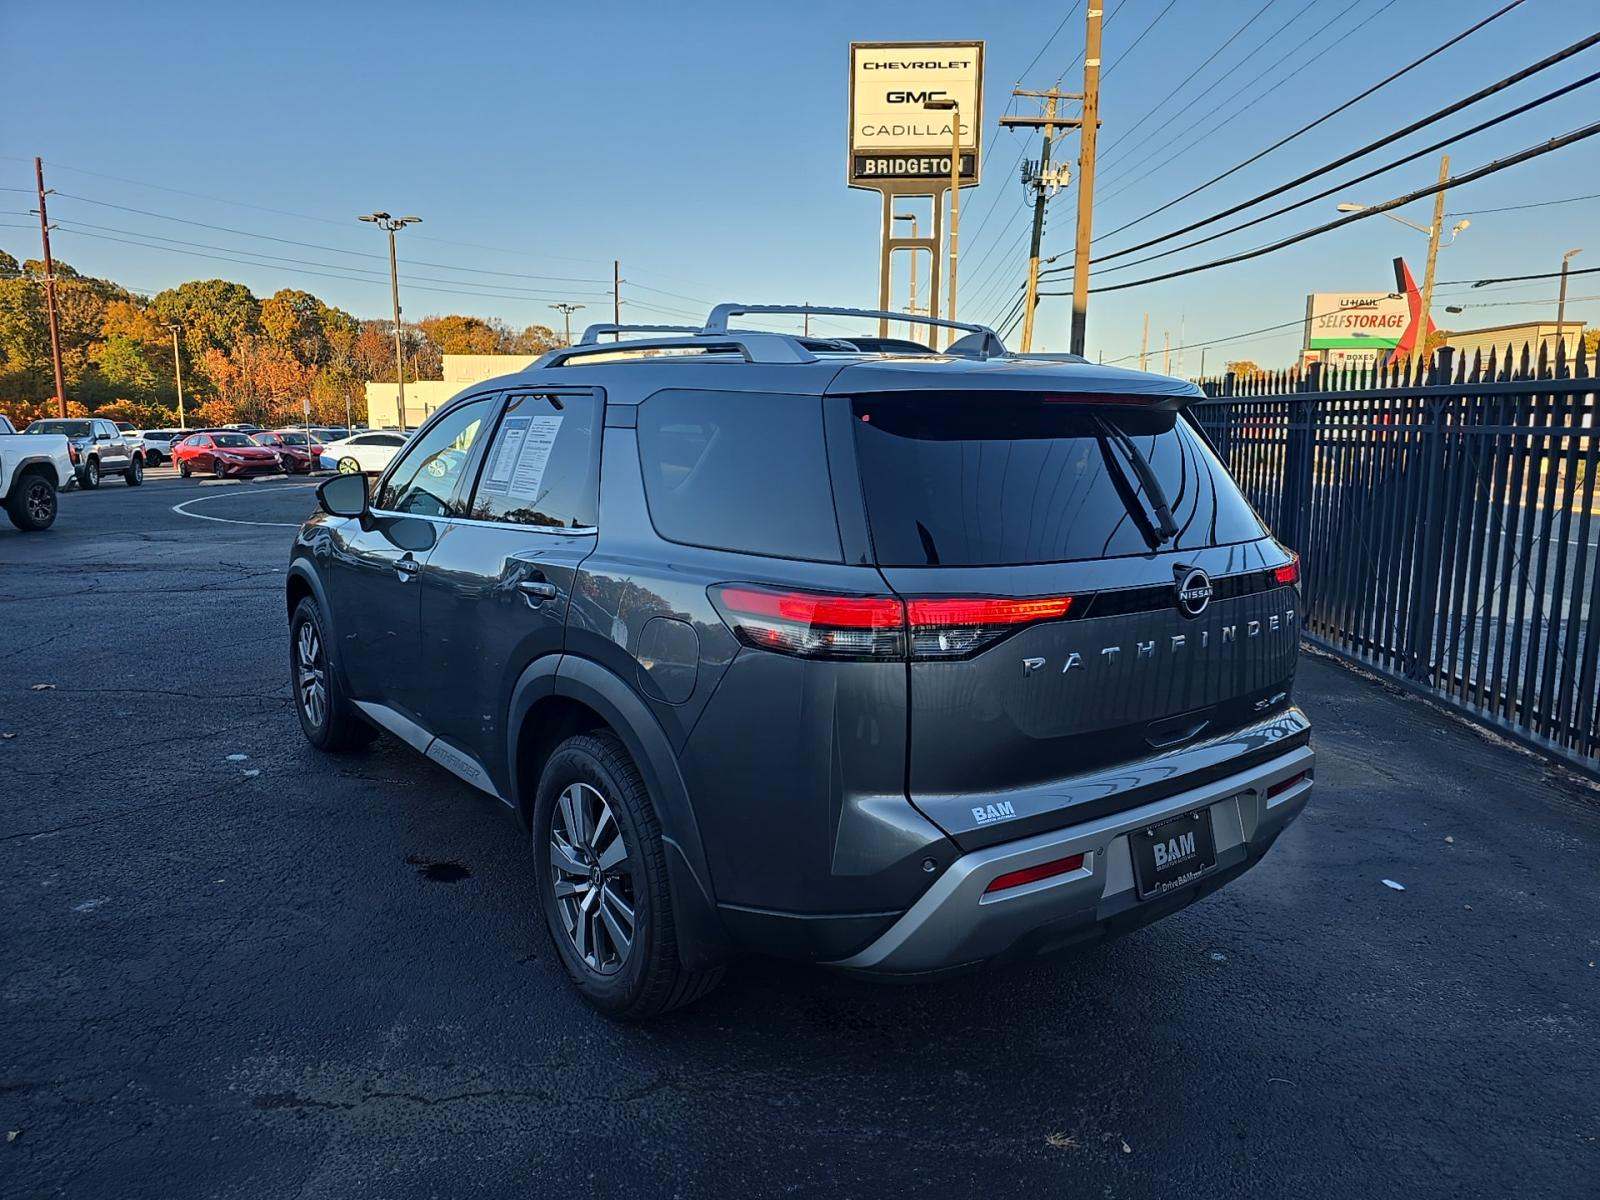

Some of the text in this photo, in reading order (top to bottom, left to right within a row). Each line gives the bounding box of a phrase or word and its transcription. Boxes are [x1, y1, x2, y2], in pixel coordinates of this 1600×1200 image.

[863, 61, 971, 70] CHEVROLET
[861, 124, 969, 137] CADILLAC
[1346, 353, 1375, 361] BOXES
[1180, 589, 1213, 600] NISSAN
[1022, 610, 1296, 678] PATHFINDER
[971, 801, 1015, 822] BAM
[1153, 831, 1196, 867] BAM
